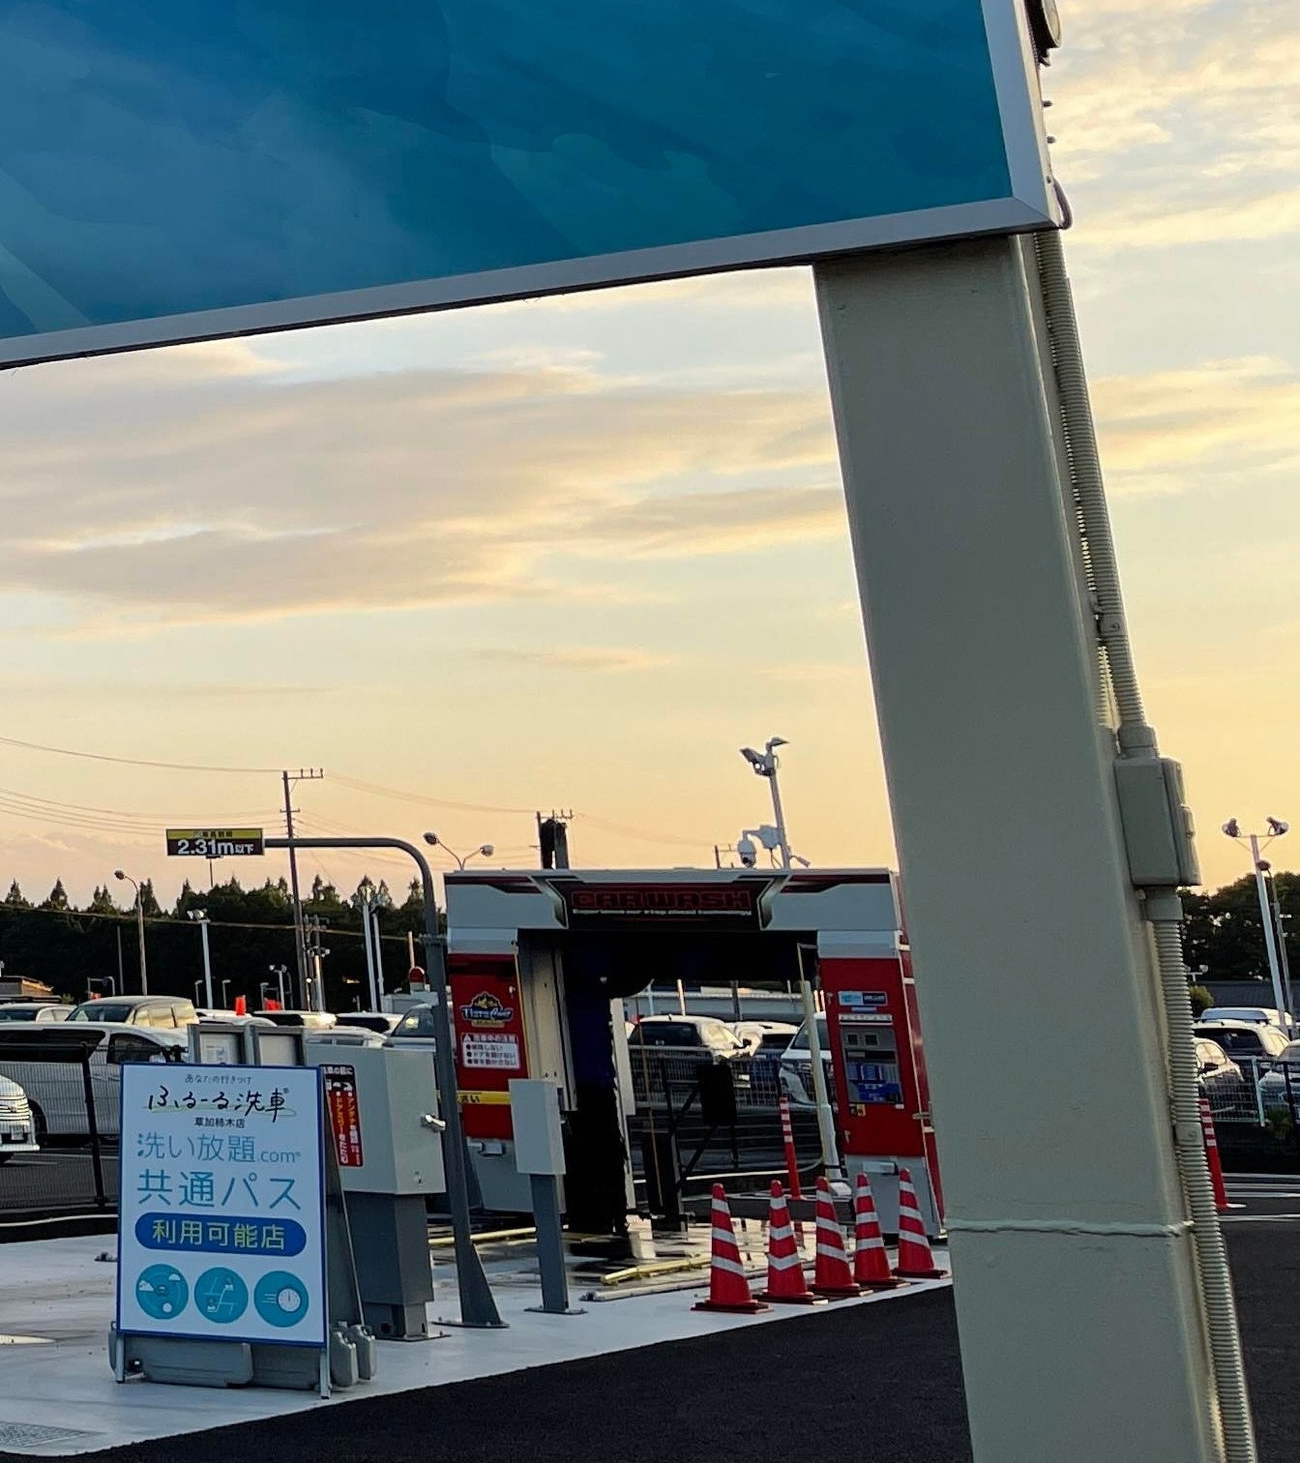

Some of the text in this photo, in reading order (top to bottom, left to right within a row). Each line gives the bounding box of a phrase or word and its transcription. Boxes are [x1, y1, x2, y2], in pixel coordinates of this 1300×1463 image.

[137, 1168, 302, 1211] 共通パス
[152, 1219, 285, 1251] 利用可能店
